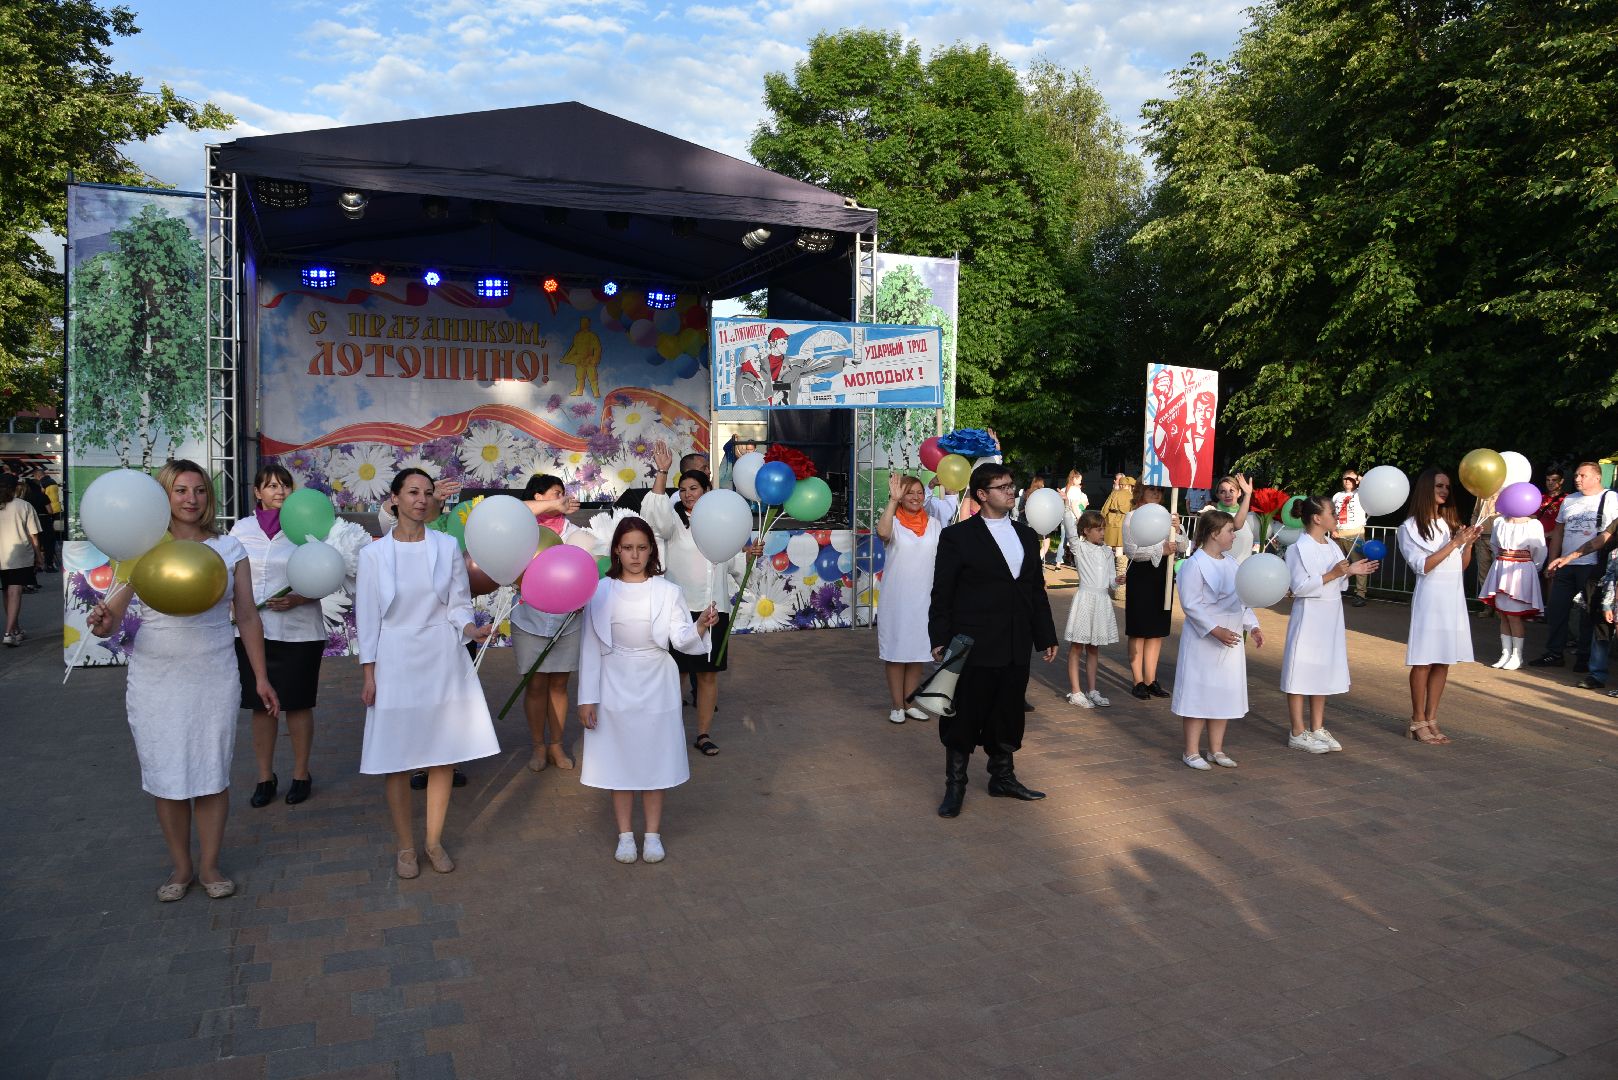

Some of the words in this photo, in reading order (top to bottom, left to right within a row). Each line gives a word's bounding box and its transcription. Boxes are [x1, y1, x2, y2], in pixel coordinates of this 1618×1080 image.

[307, 310, 328, 335] С
[347, 312, 548, 348] ПРАЗДНИКОМ,
[864, 338, 904, 361] УДАРНЫЙ
[907, 338, 928, 354] ТРУД
[306, 340, 550, 384] ЛОТОШИНО!
[843, 367, 914, 388] МОЛОДЫХ
[1181, 368, 1195, 387] 12
